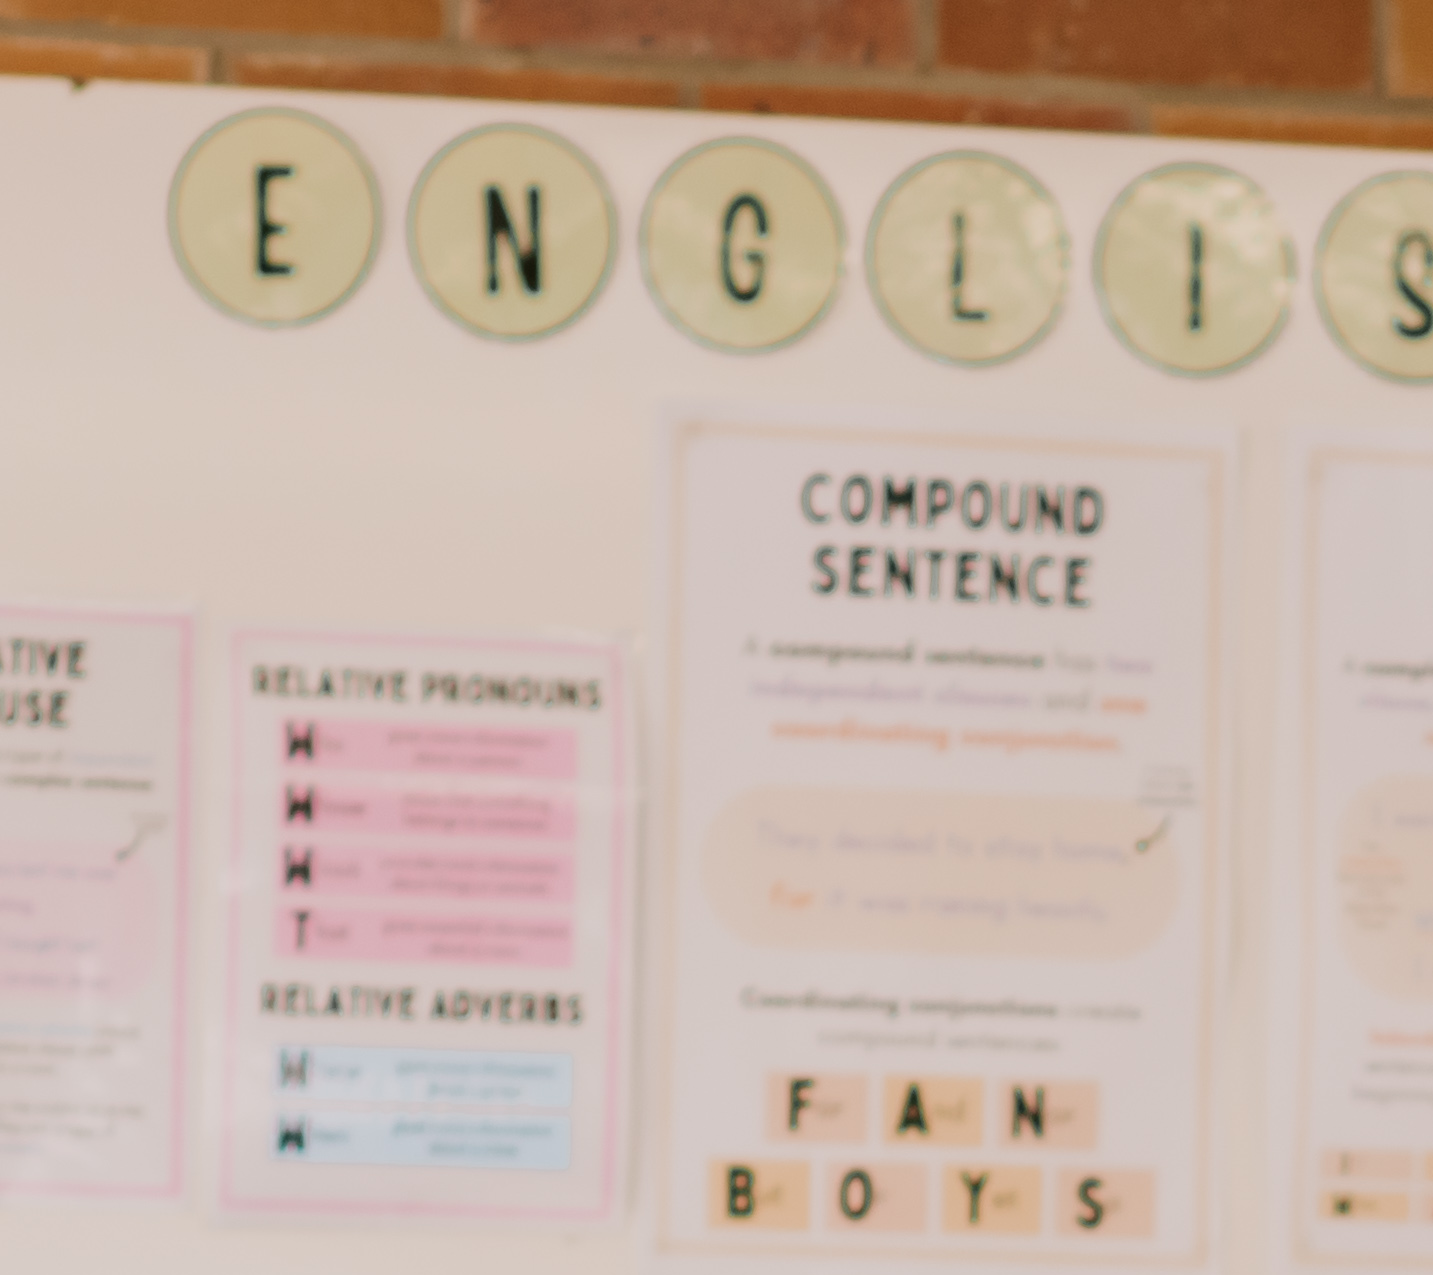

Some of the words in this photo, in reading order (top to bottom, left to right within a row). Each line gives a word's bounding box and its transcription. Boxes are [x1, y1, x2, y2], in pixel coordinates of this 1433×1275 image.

[801, 473, 1104, 536] COMPOUND
[811, 544, 1091, 607] SENTENCE
[253, 666, 407, 703] RELATIVE
[421, 673, 601, 710] PRONOUNS
[261, 983, 416, 1021] RELATIVE
[431, 990, 583, 1025] ADVERBS
